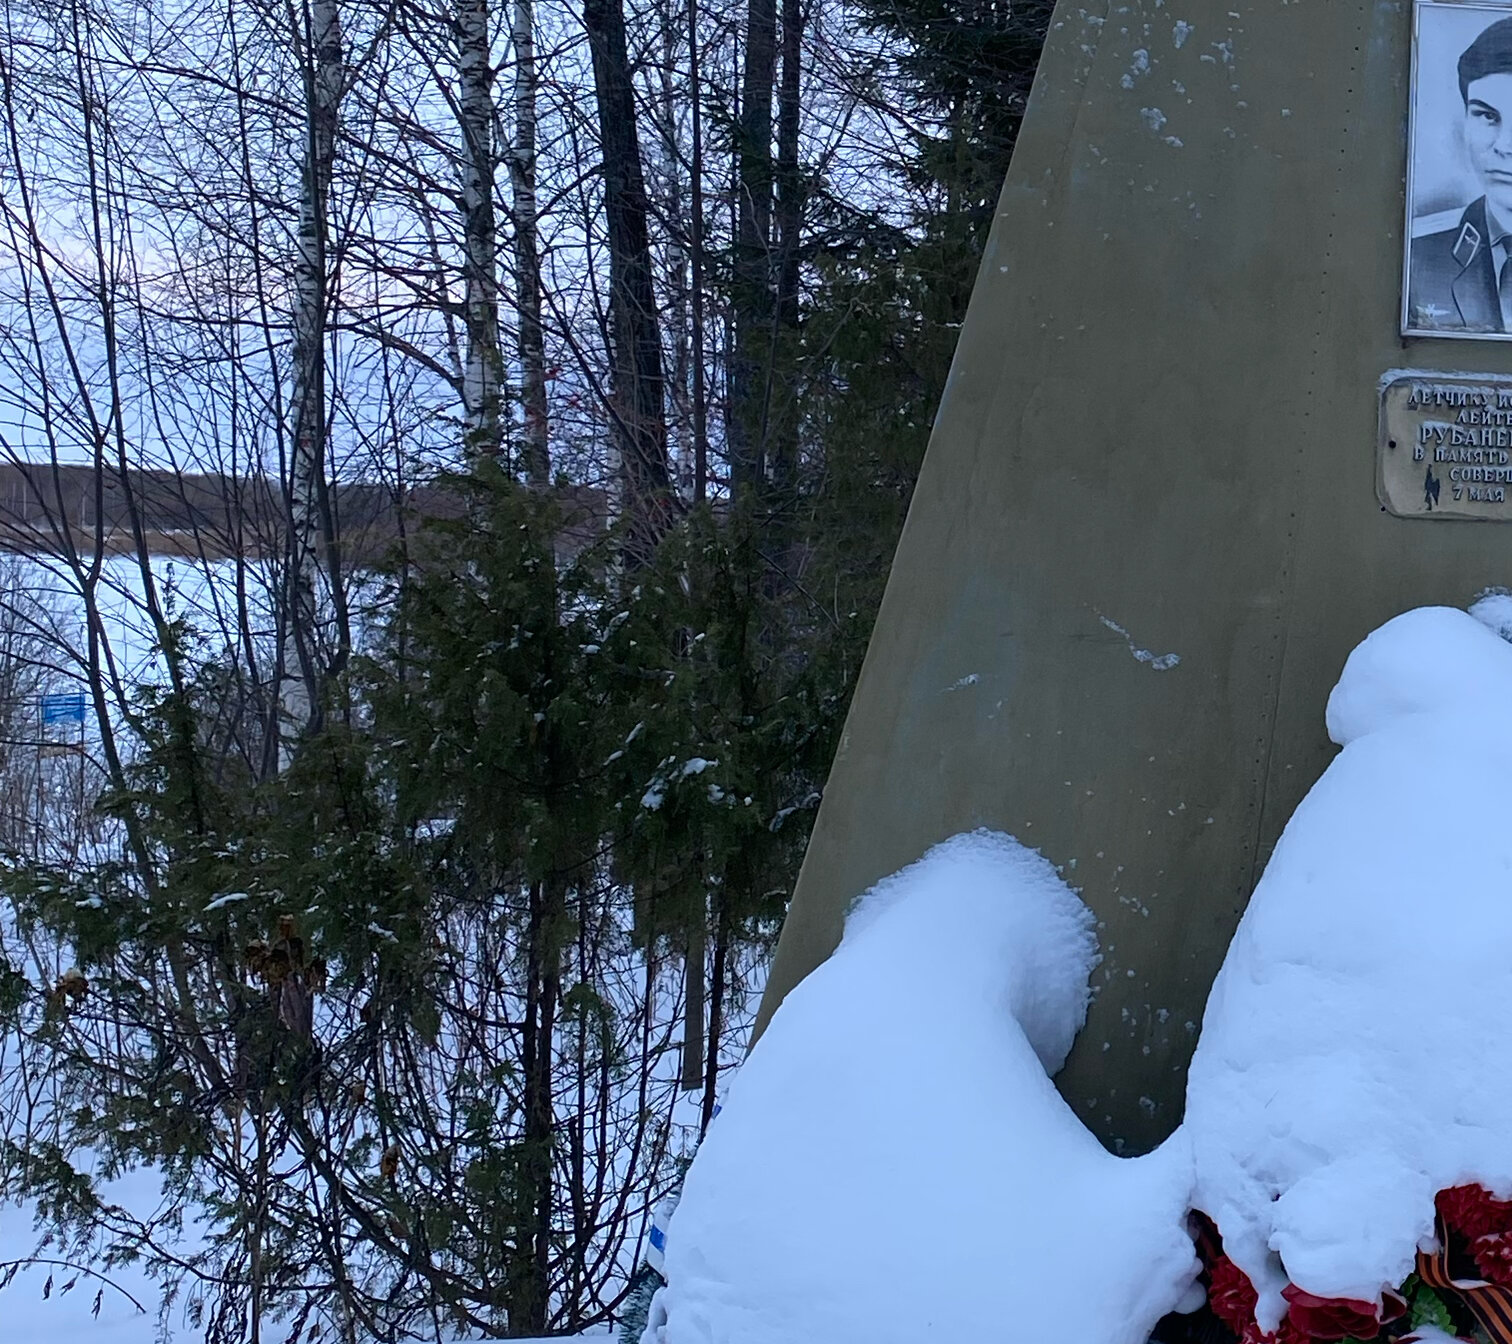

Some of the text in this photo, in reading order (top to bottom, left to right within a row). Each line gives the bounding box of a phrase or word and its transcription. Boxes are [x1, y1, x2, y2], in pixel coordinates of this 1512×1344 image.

[1413, 446, 1425, 461] В
[1434, 446, 1508, 464] ПАМЯТЬ
[1453, 485, 1464, 500] 7
[1468, 486, 1505, 502] МАЯ
